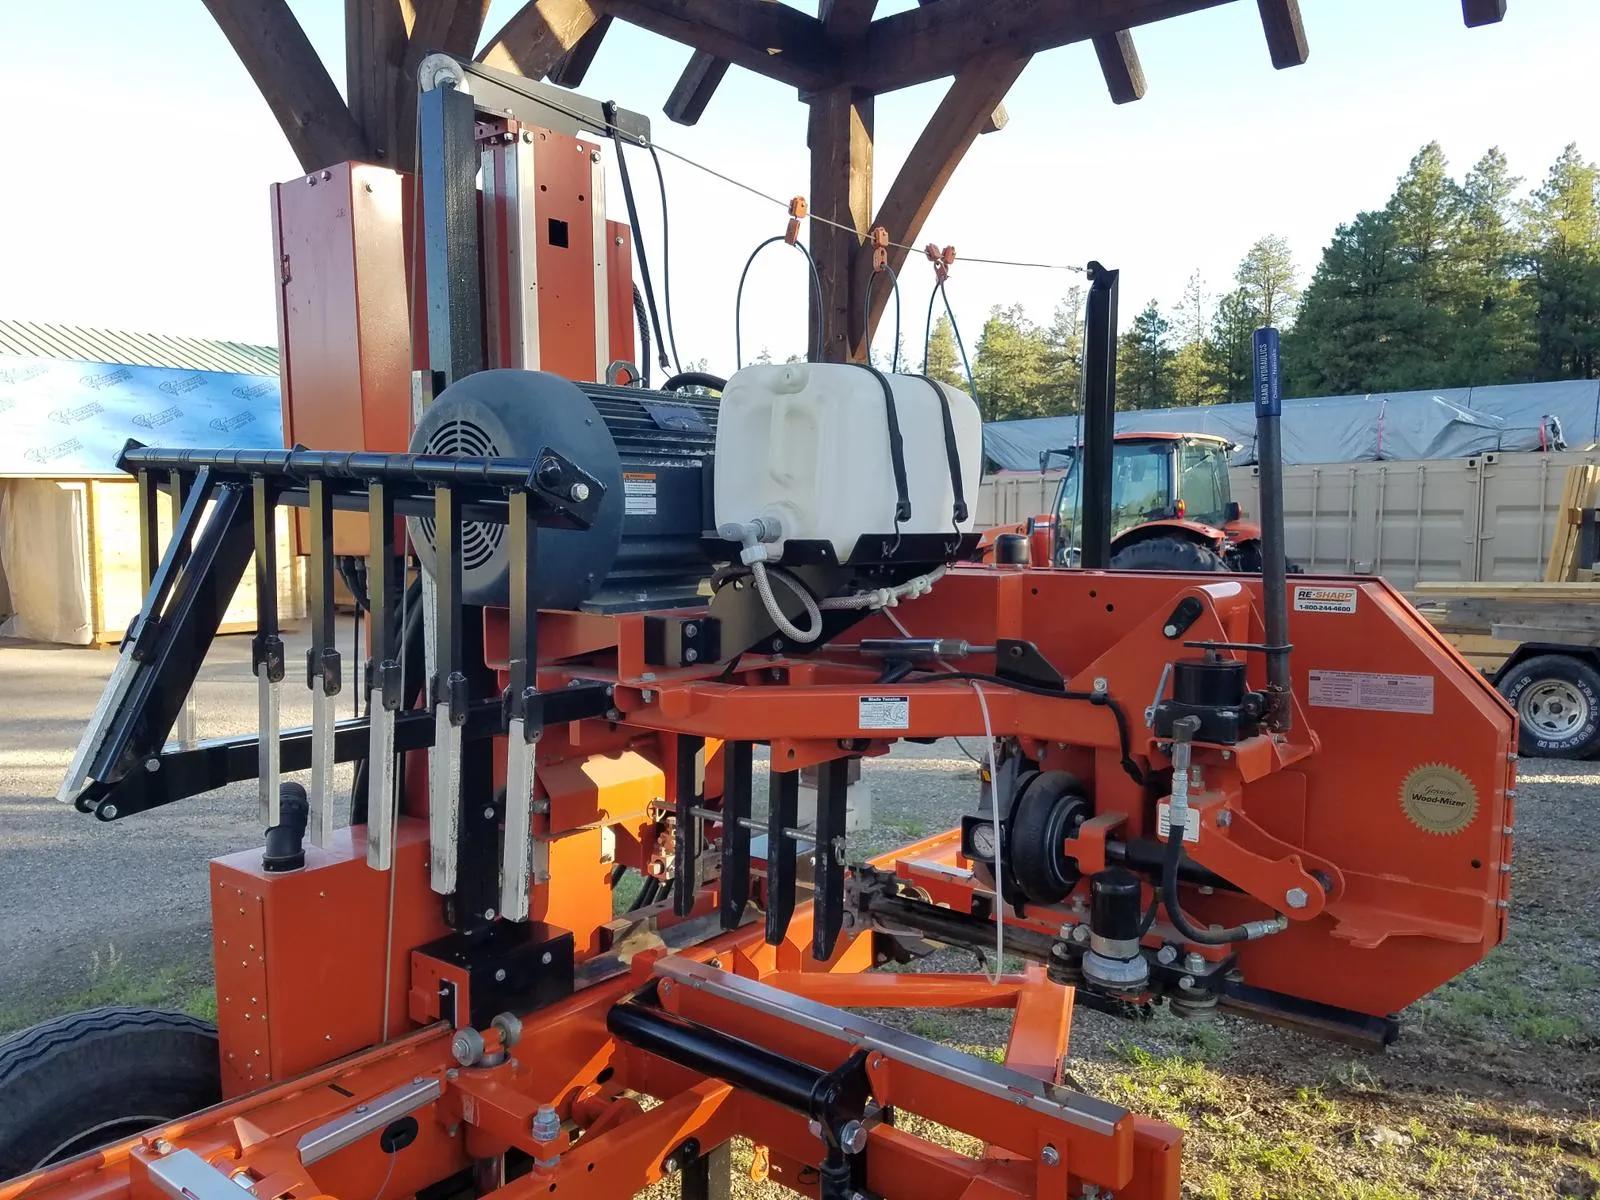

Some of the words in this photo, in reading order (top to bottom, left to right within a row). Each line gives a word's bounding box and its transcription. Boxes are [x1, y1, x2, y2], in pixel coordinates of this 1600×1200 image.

[1260, 343, 1268, 382] HYDRAULICS
[1261, 383, 1269, 405] BRAND
[1577, 680, 1598, 720] TRAIL
[1537, 724, 1594, 749] BUSTER
[1411, 793, 1467, 807] Wood-Mizer
